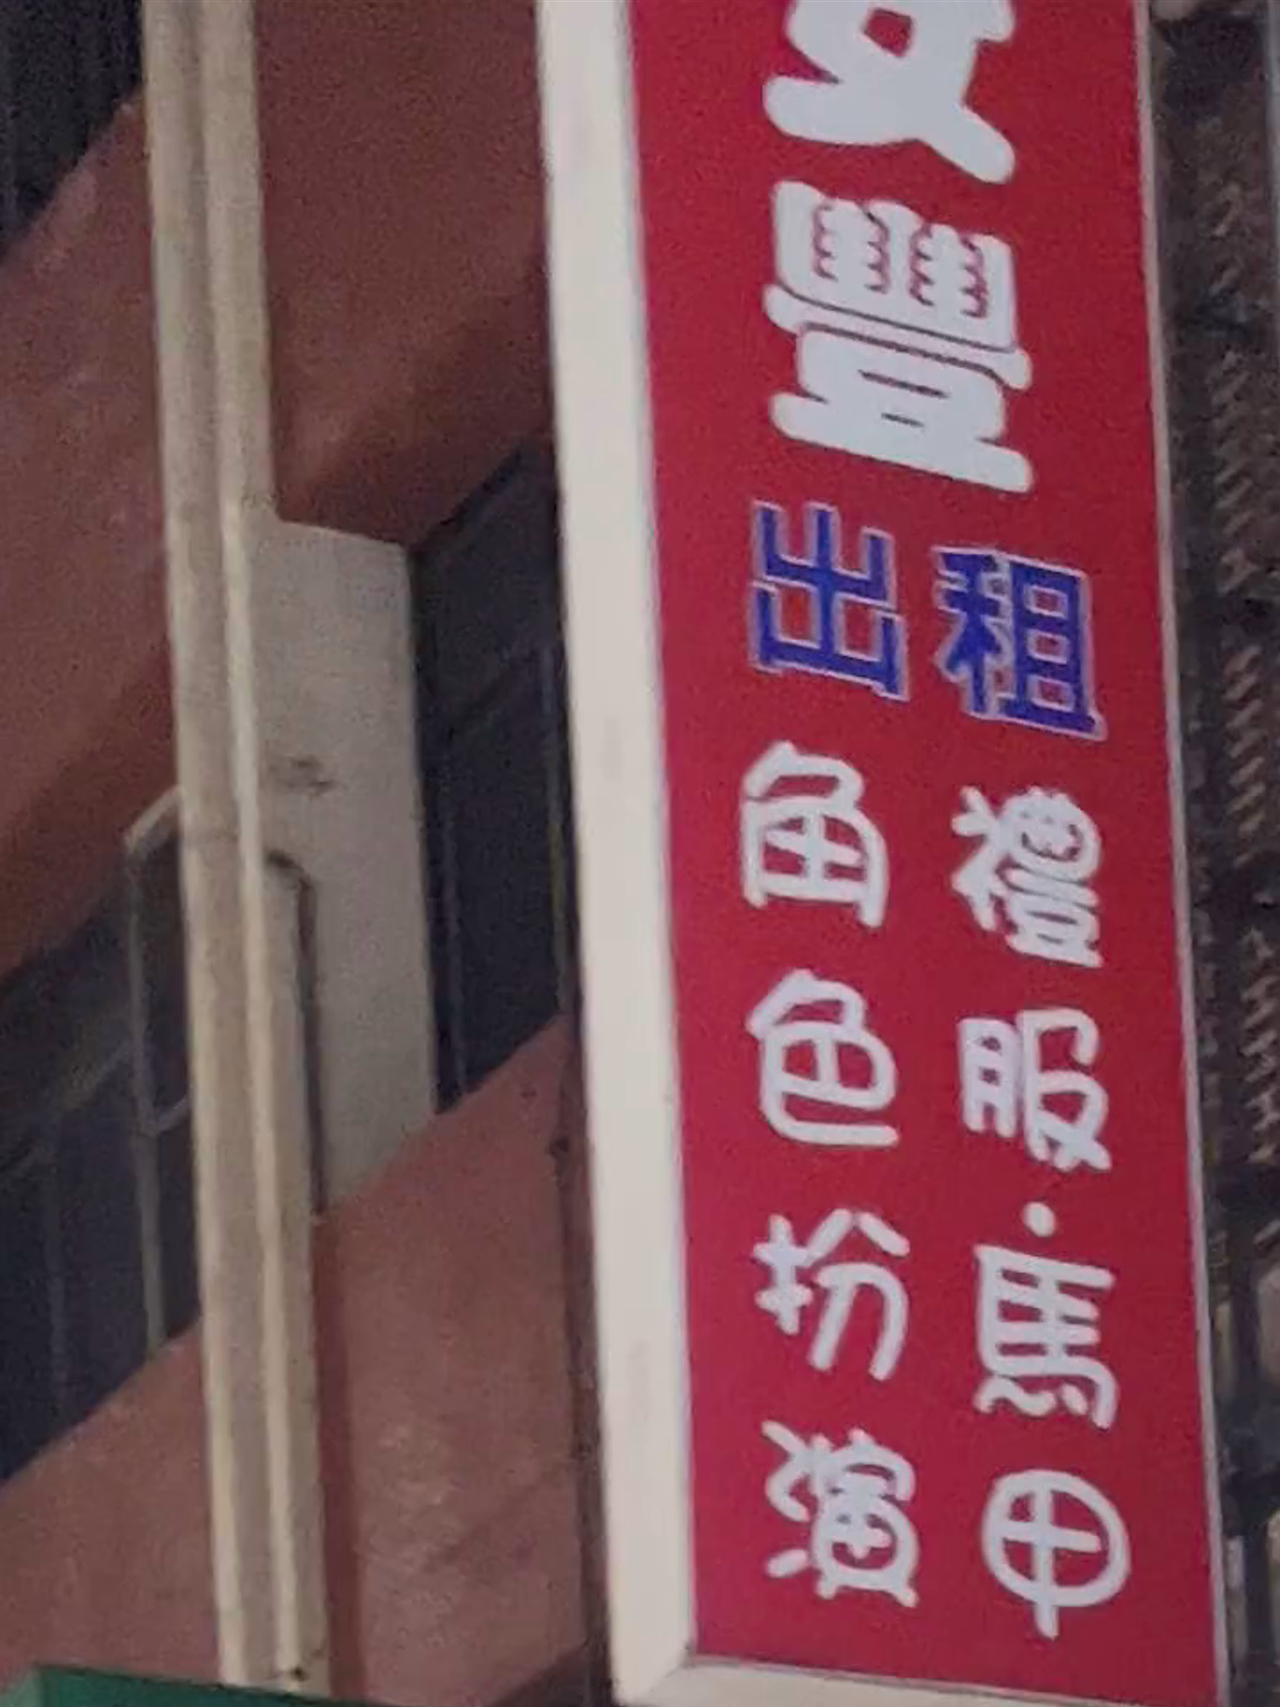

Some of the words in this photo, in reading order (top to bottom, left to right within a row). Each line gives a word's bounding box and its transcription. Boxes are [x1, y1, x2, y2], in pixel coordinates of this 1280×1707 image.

[749, 502, 1108, 741] 出租
[739, 740, 918, 1608] 角色扮演
